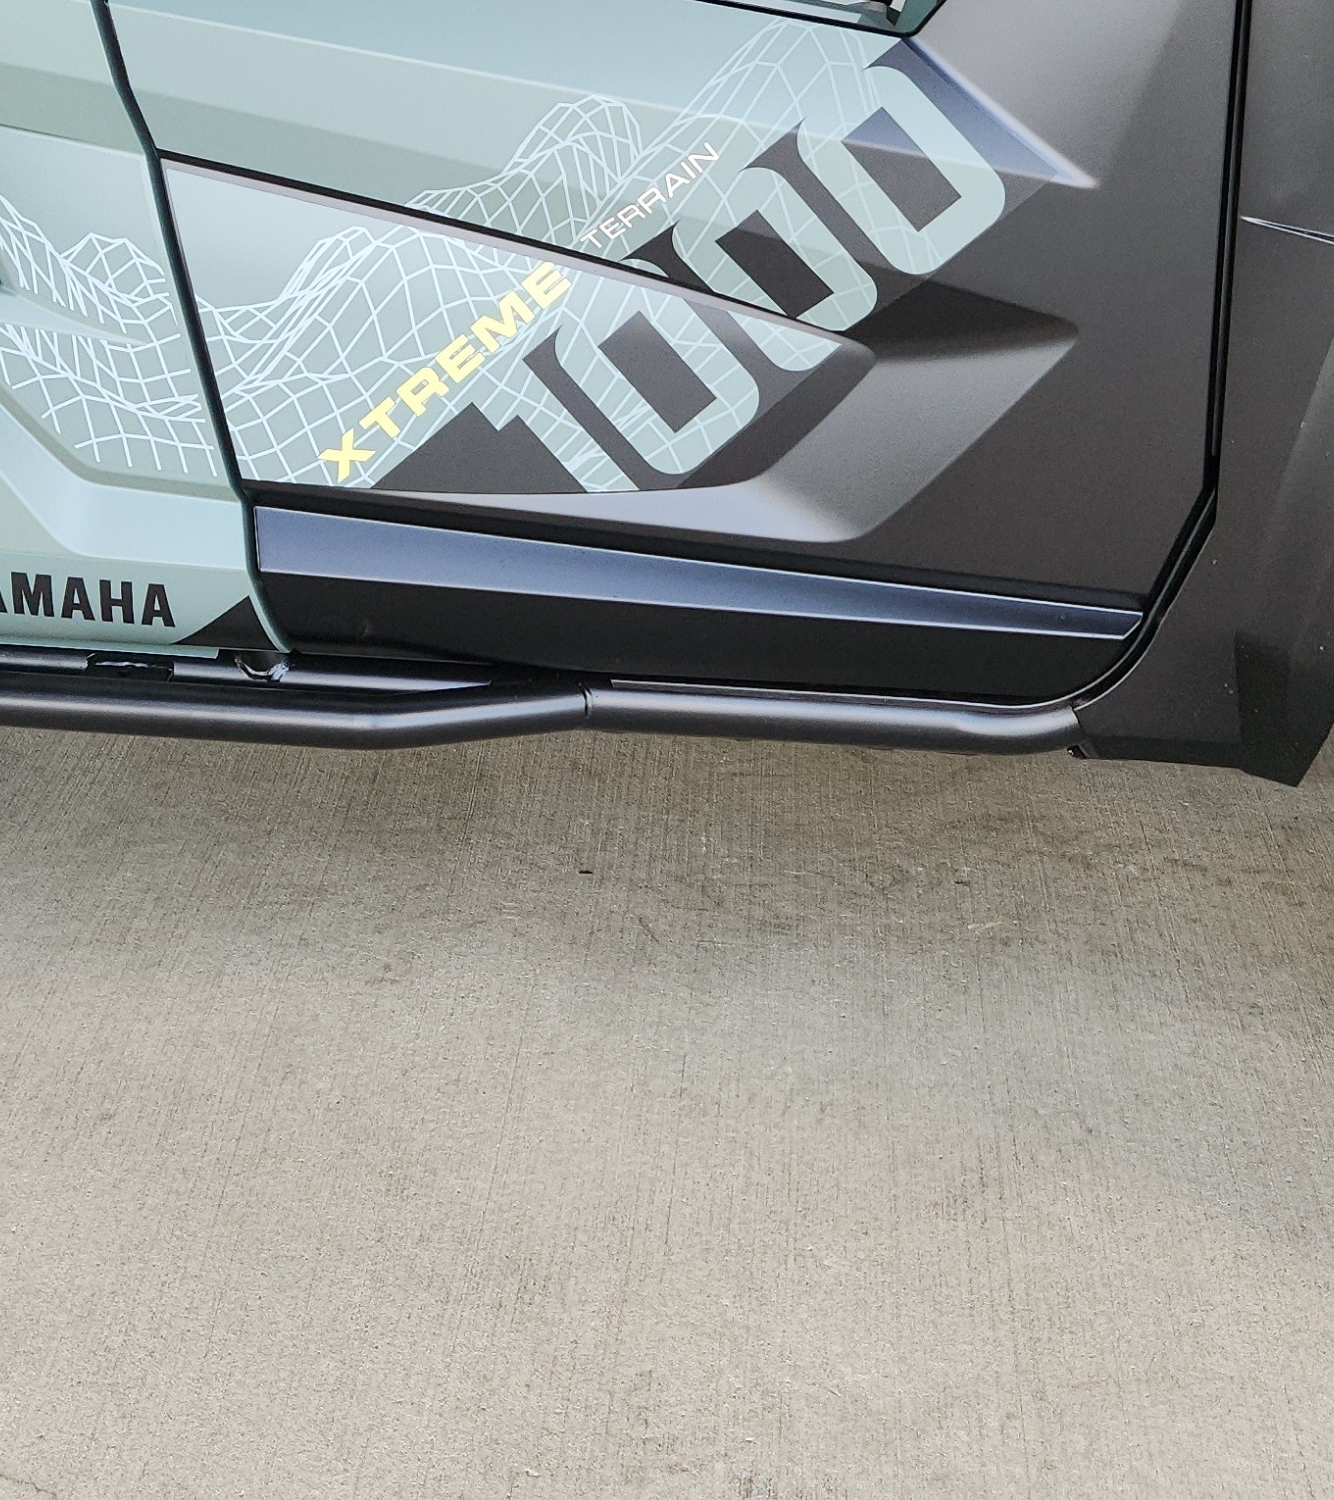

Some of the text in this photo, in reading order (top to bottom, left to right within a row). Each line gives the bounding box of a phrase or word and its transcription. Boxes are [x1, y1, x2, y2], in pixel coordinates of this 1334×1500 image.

[317, 141, 721, 483] XTREME TERRAIN
[472, 65, 1006, 492] 1000
